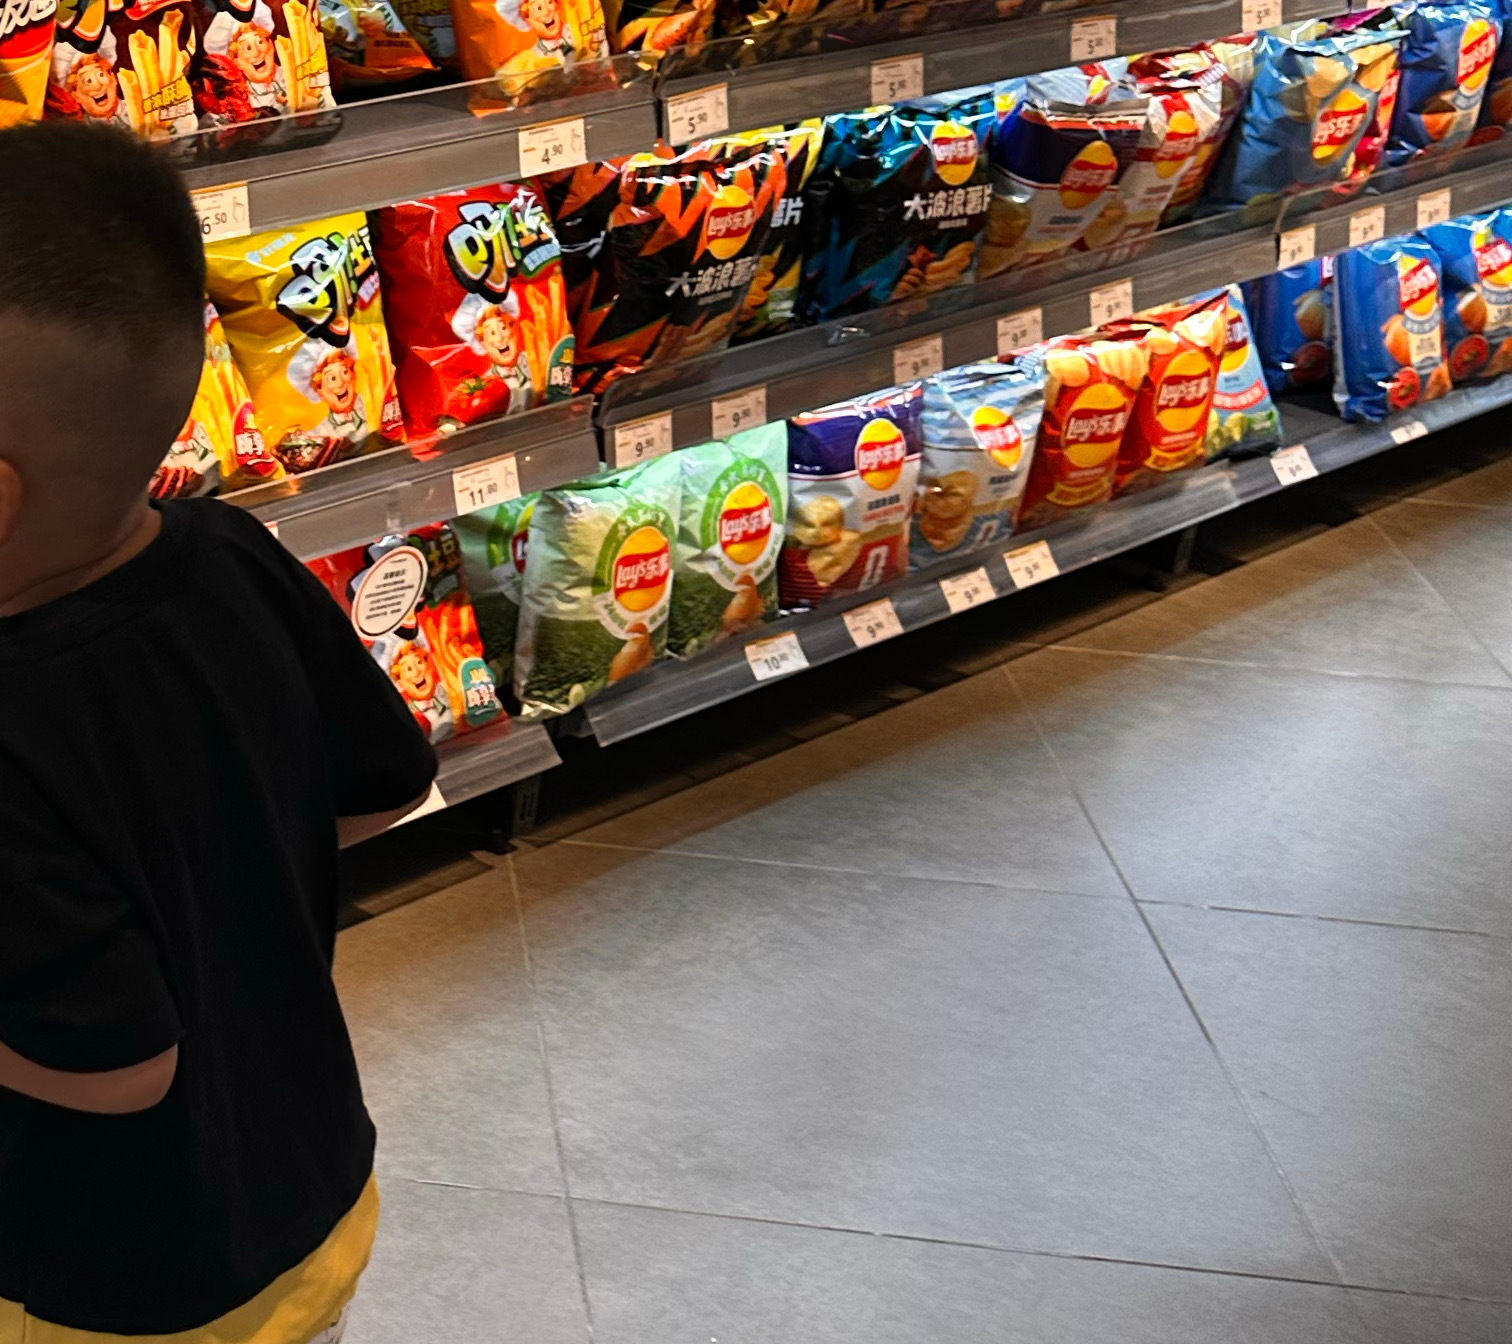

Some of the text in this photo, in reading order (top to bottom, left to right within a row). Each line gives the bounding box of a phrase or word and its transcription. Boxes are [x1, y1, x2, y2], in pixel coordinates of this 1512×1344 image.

[687, 112, 708, 134] 5.90
[540, 143, 564, 166] 4.90
[200, 211, 228, 236] 6.50
[615, 551, 670, 590] Lay's乐事
